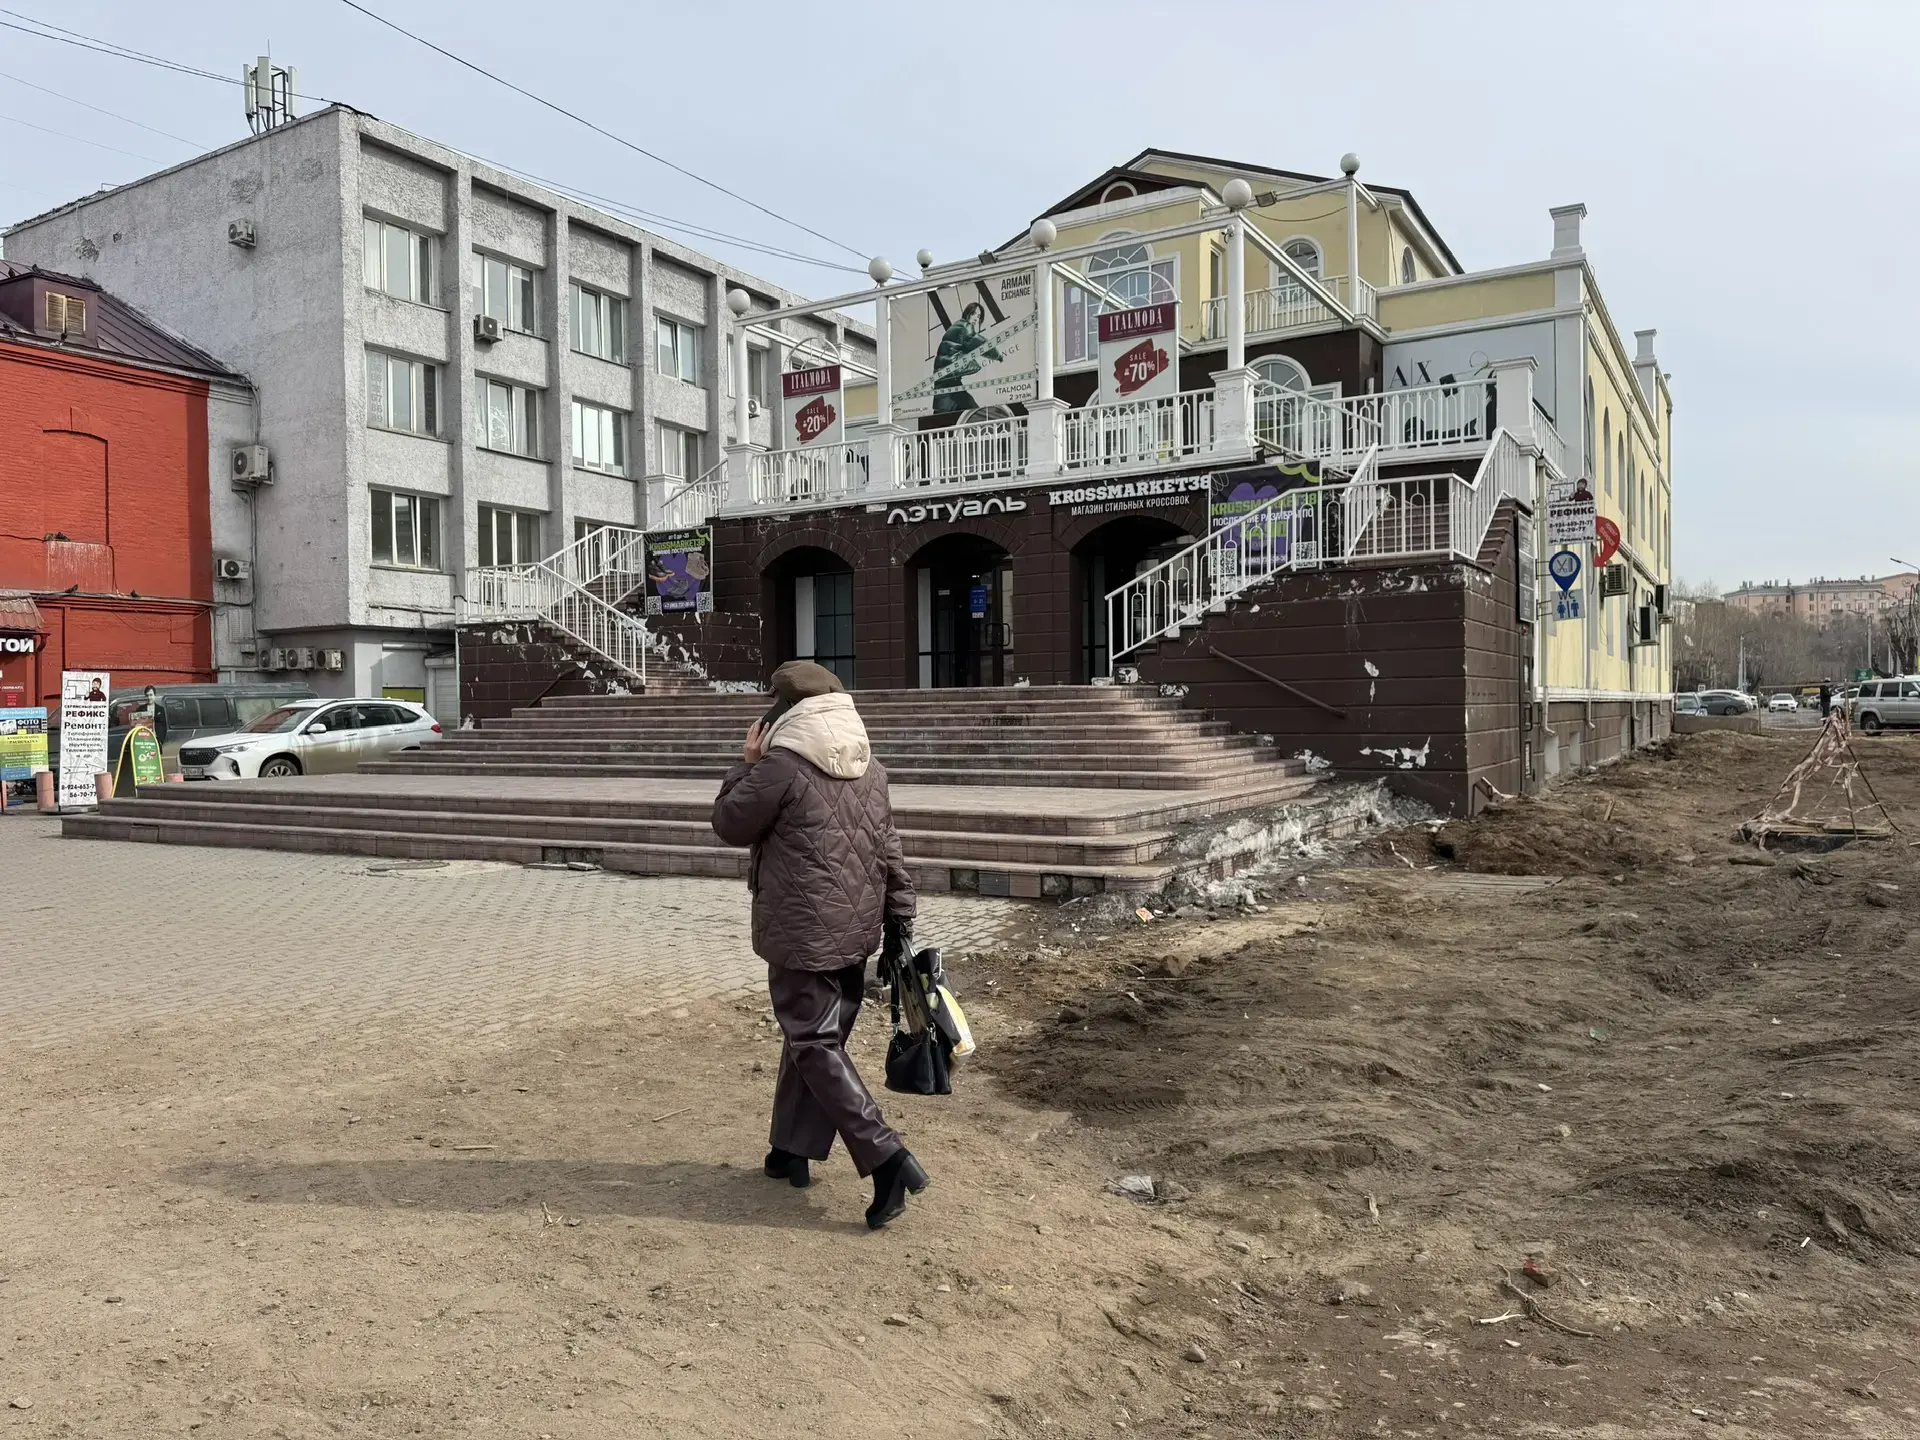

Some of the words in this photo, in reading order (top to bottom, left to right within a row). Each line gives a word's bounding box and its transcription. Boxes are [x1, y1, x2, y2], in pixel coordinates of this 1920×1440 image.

[1001, 274, 1031, 290] ARMANI
[1001, 287, 1031, 301] EXCHANGE
[1109, 308, 1162, 332] ITALMODA
[1130, 352, 1147, 361] SALE
[791, 369, 831, 390] ITALMODA
[996, 383, 1031, 395] ITALMODA
[1049, 475, 1210, 505] KROSSMARKET38
[1071, 503, 1103, 516] МАГАЗИН
[1104, 500, 1144, 513] СТИЛЬНЫХ
[1145, 495, 1190, 509] КРОССОВОК
[1550, 506, 1594, 518] РЕФИКС
[1558, 591, 1576, 600] WC
[65, 710, 105, 718] РЕФИКС
[64, 721, 106, 730] Ремонт:
